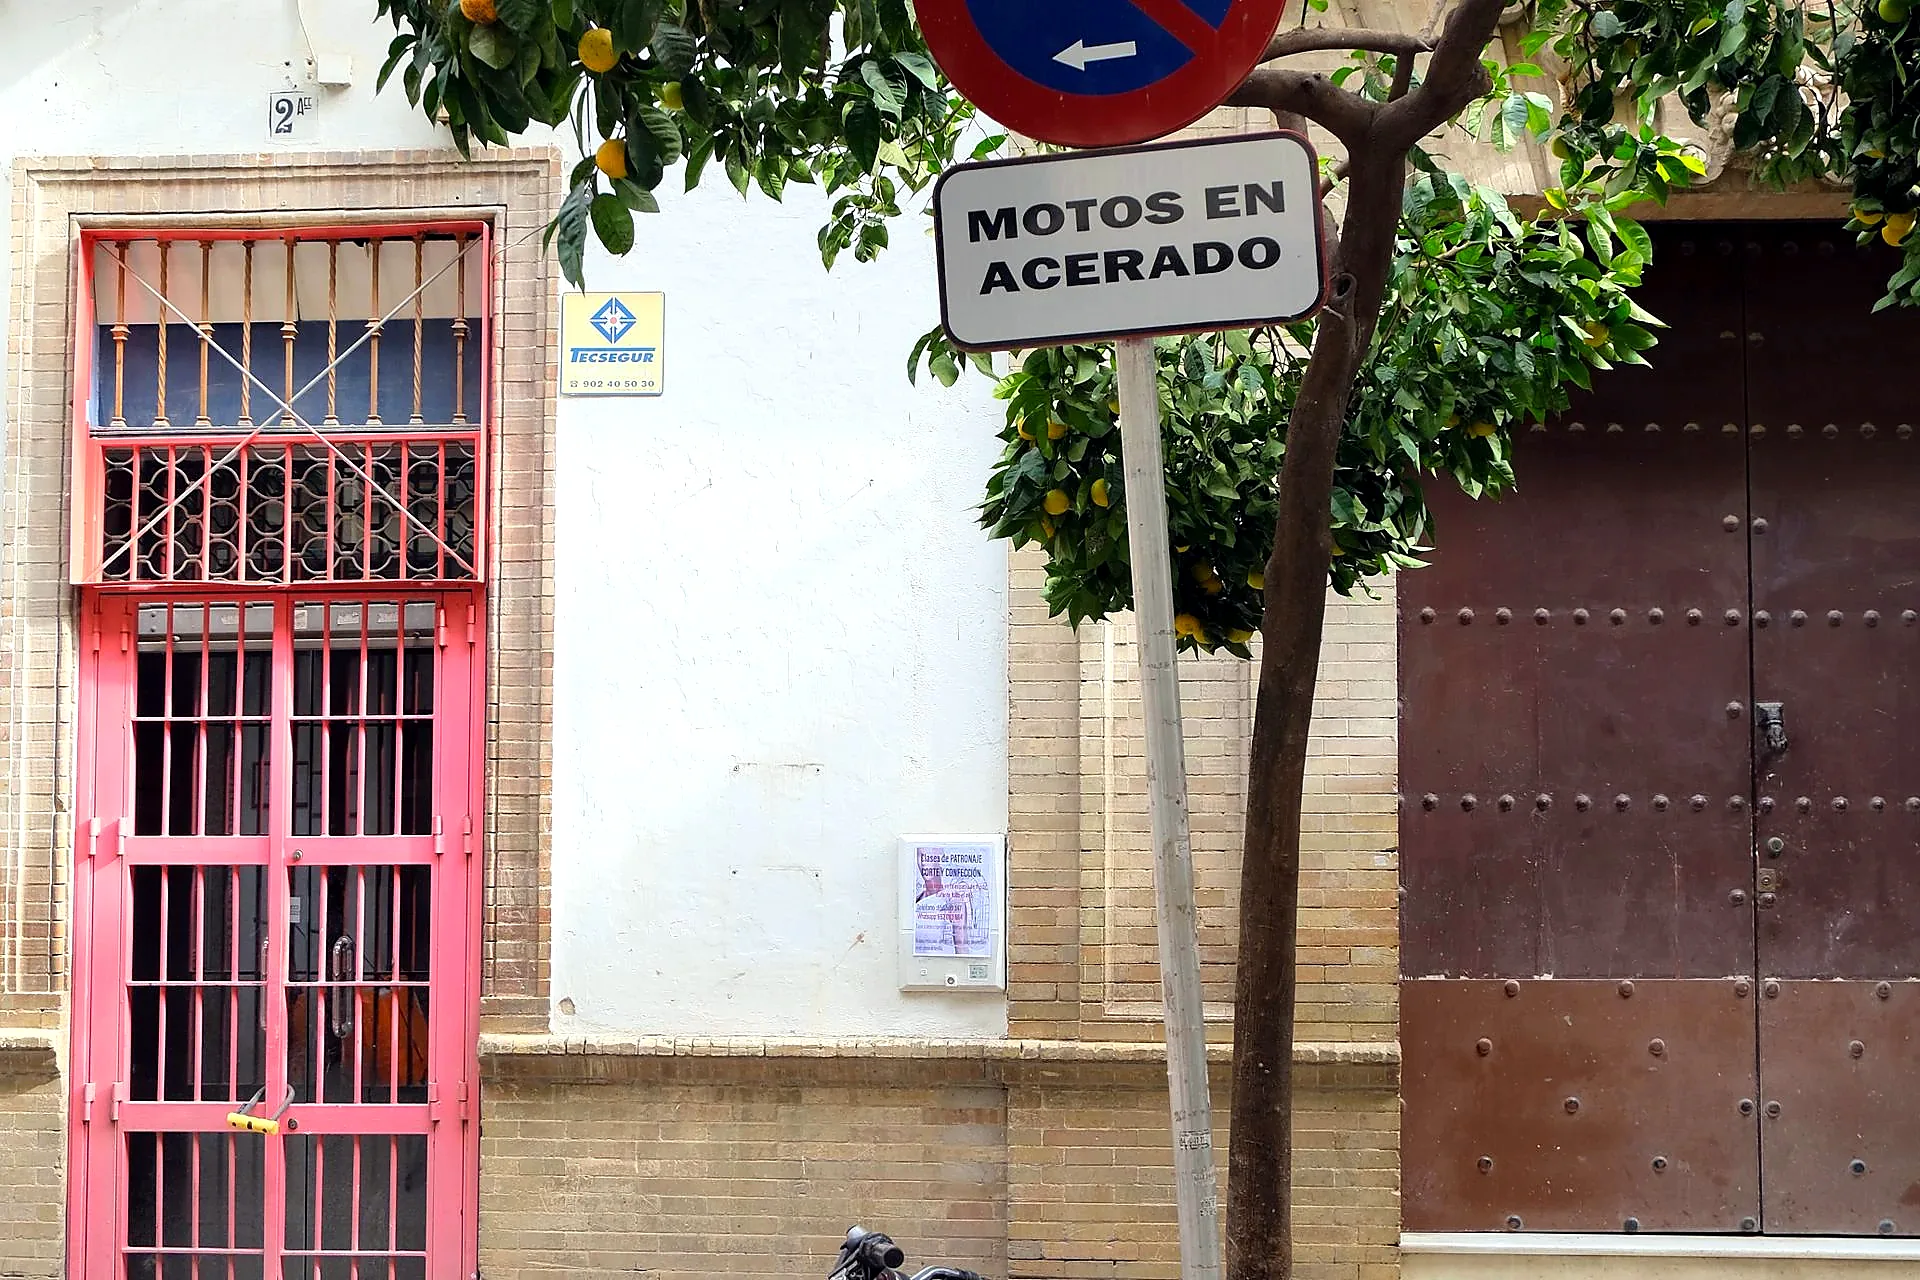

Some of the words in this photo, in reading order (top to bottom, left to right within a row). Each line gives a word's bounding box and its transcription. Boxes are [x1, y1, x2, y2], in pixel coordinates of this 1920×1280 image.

[275, 98, 293, 133] 2
[968, 191, 1184, 243] MOTOS
[1204, 180, 1285, 220] EN
[979, 236, 1281, 295] ACERADO
[570, 348, 656, 363] TECSEGUR
[583, 380, 603, 388] 902
[607, 380, 620, 388] 40
[624, 380, 638, 388] 50
[641, 380, 655, 388] 30
[941, 853, 950, 862] de
[950, 854, 982, 864] PATRONAJE
[921, 867, 940, 877] CORTE
